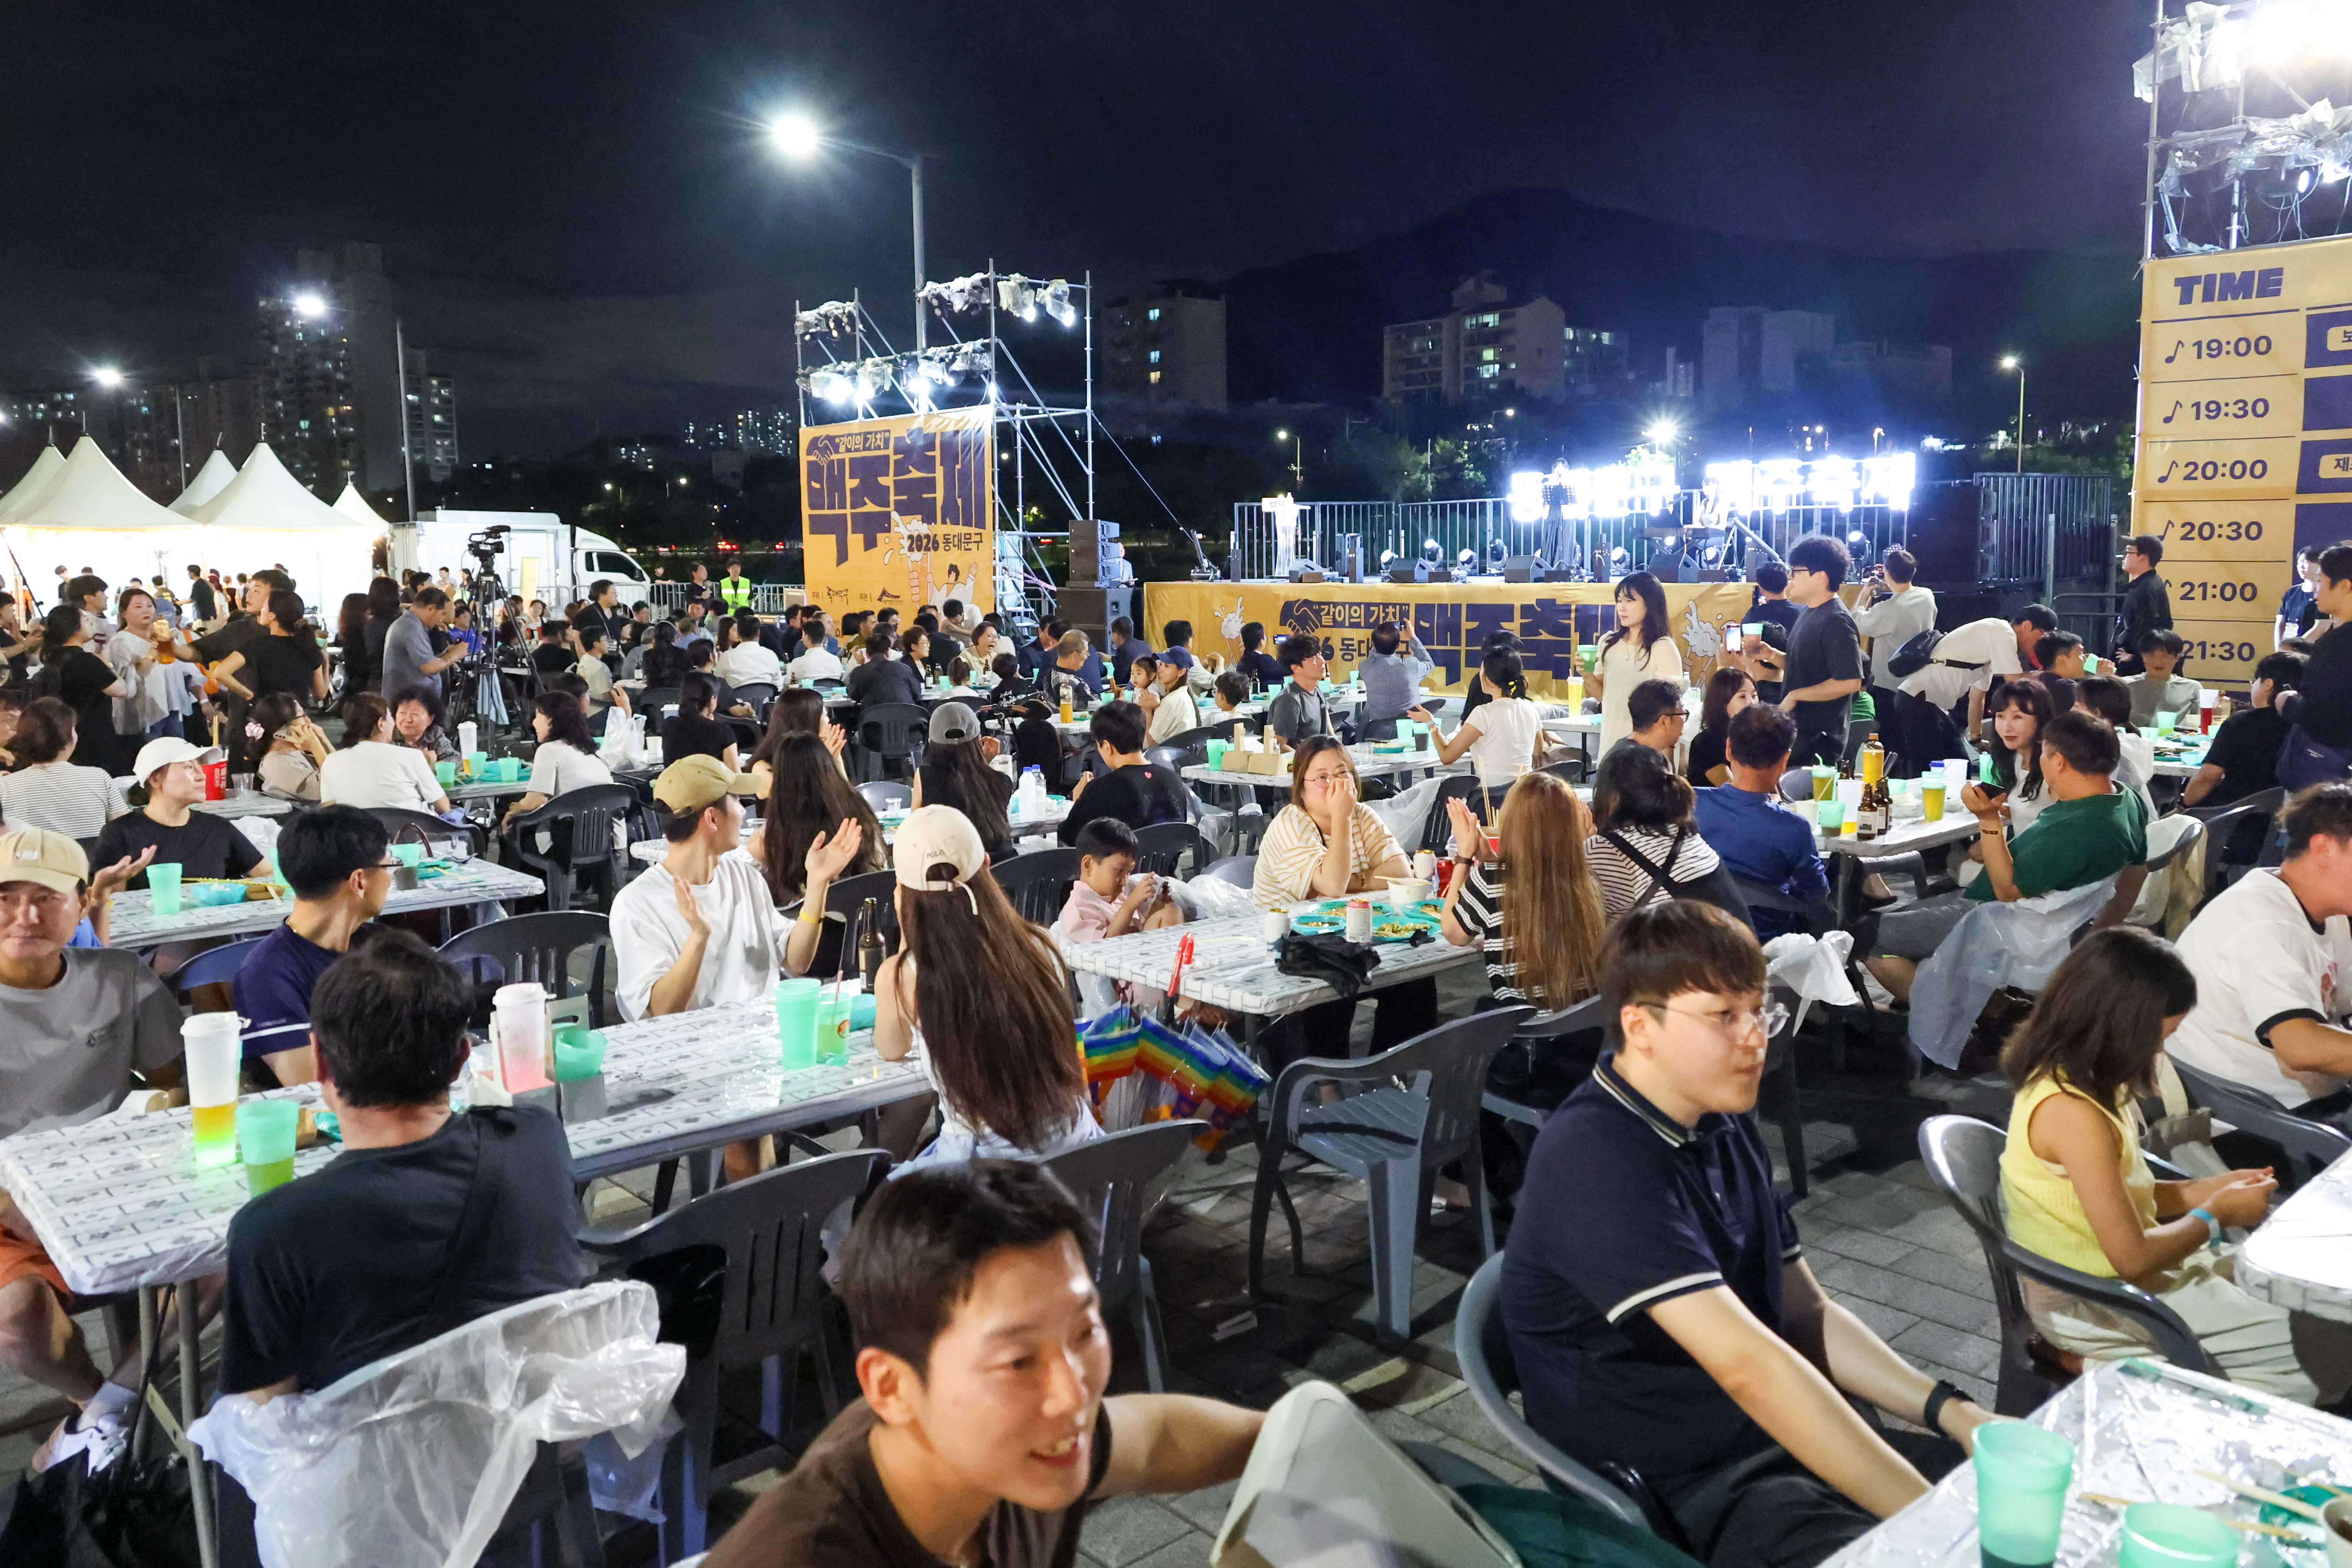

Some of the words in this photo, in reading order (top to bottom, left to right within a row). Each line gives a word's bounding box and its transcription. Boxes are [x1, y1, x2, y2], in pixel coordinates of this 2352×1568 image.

[2174, 267, 2283, 305] TIME
[2192, 335, 2272, 359] 19:00
[2191, 398, 2270, 421] 19:30
[2183, 460, 2268, 480] 20:00
[2180, 521, 2263, 541] 20:30
[907, 533, 939, 552] 2026
[942, 532, 983, 551] 동대문구
[2180, 582, 2257, 602] 21:00
[1339, 637, 1411, 662] 동대구
[2182, 640, 2255, 661] 21:30
